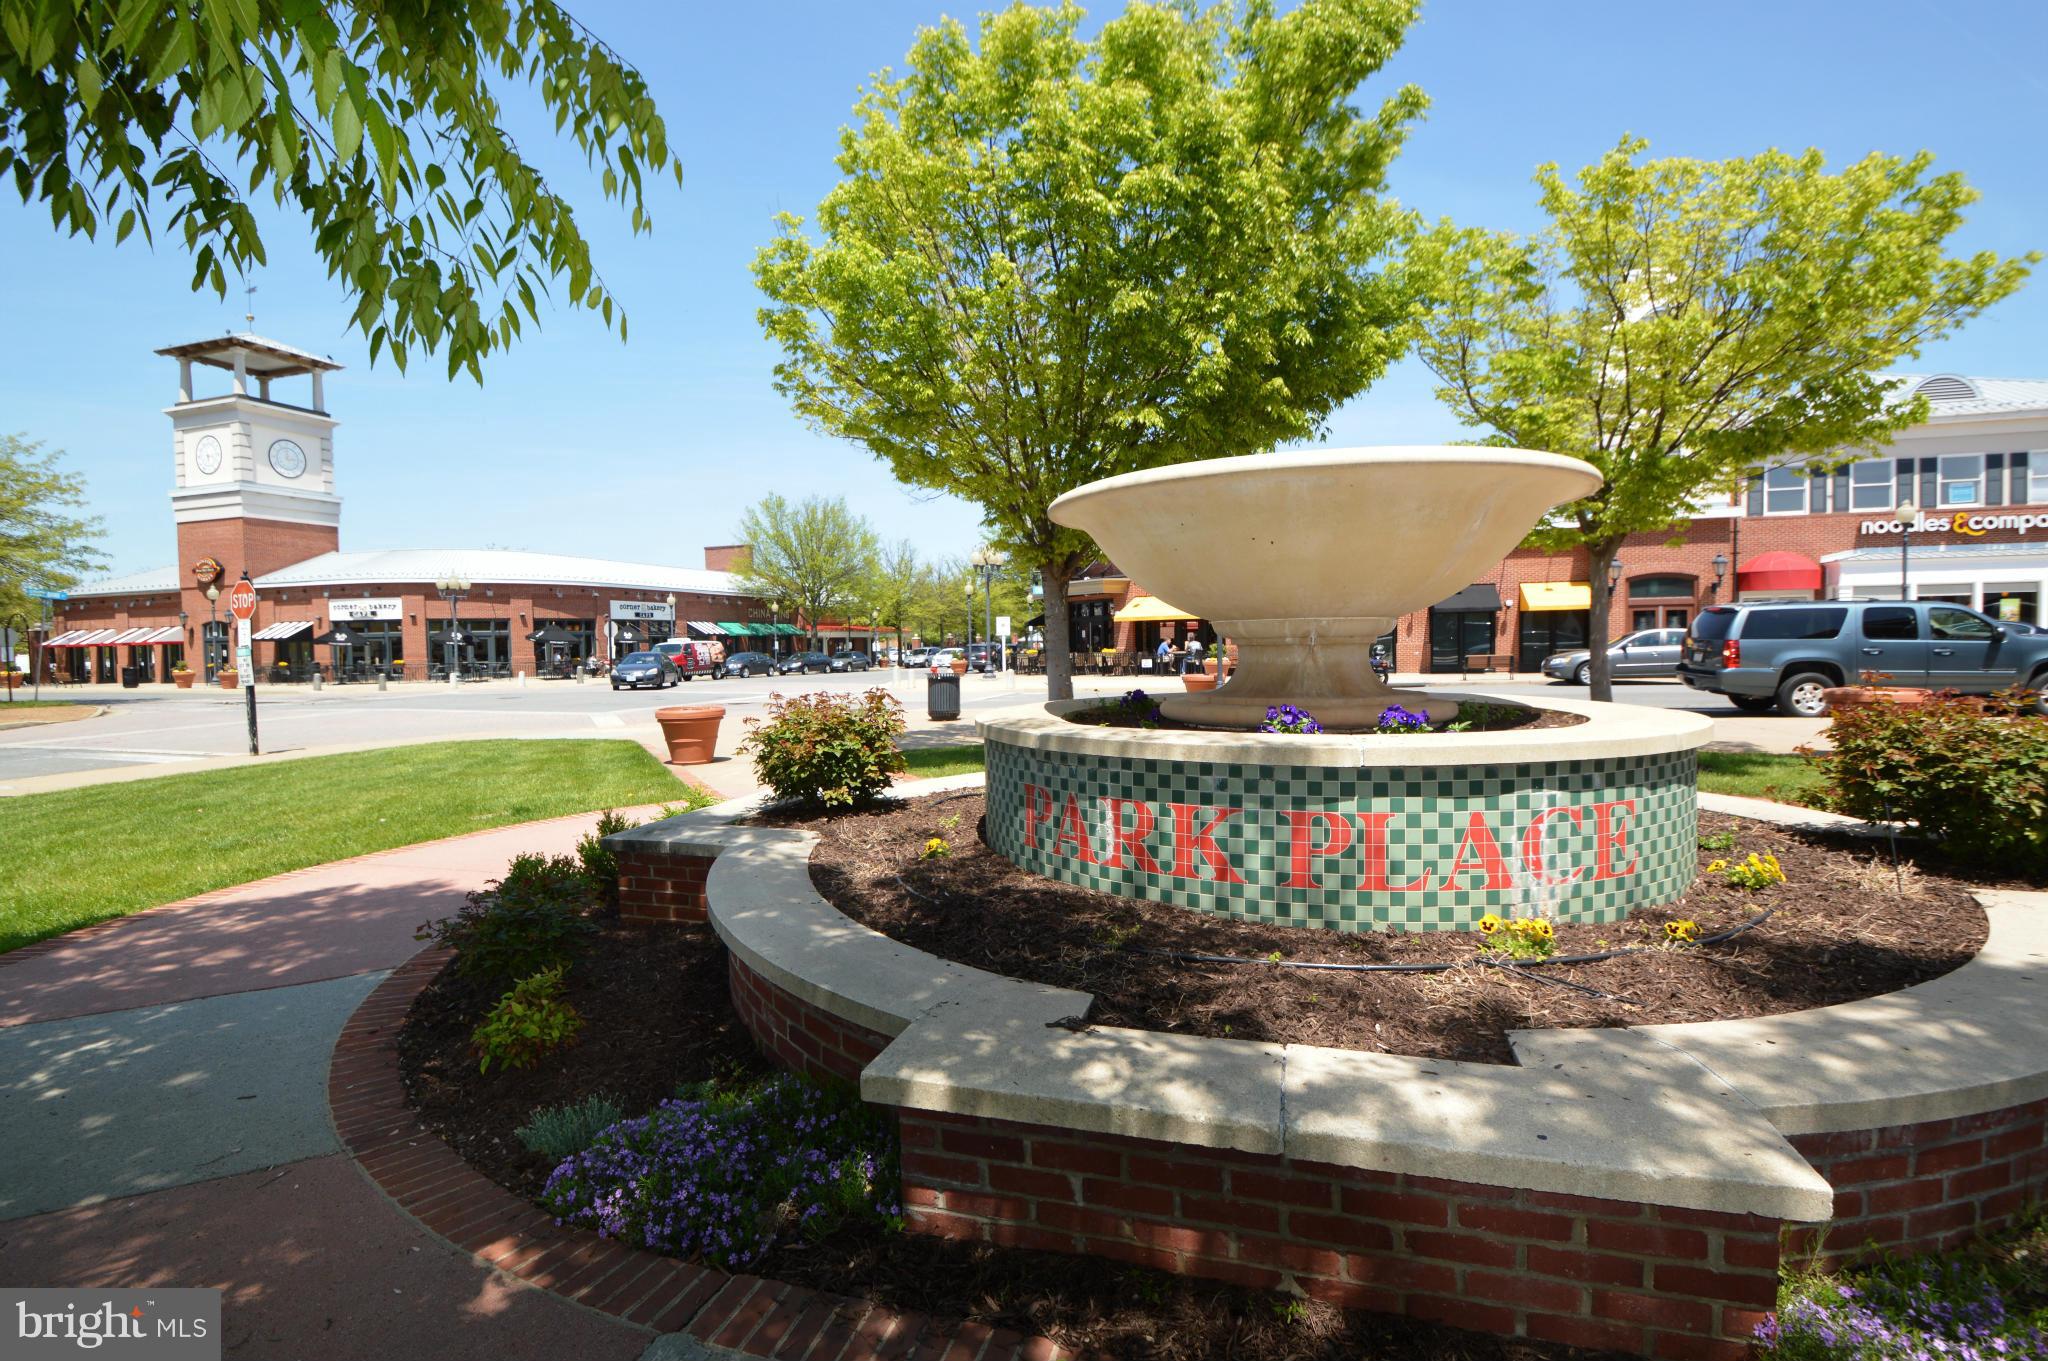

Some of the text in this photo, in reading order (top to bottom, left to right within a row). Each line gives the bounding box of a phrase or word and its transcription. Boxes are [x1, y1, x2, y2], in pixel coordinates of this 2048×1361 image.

[232, 593, 253, 609] STOP
[619, 603, 666, 612] corner bakery
[748, 607, 771, 619] CHINA
[1023, 783, 1640, 892] PARK PLACE
